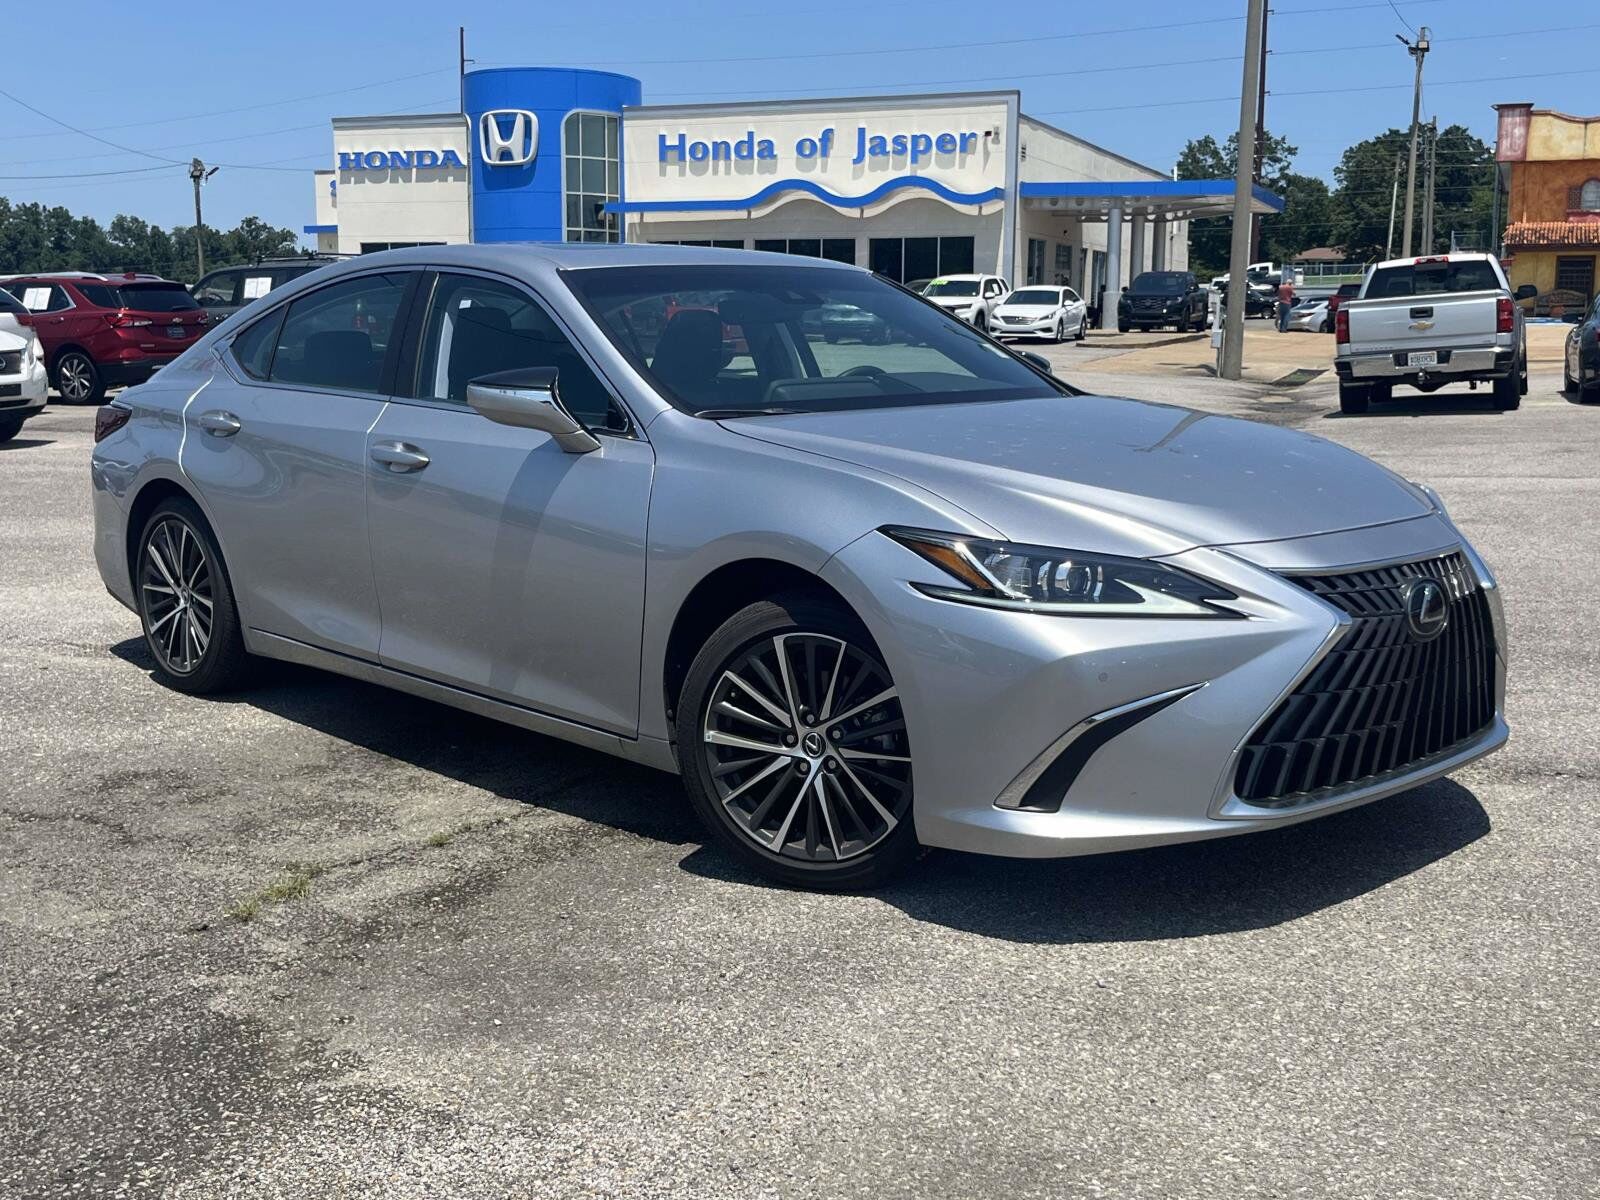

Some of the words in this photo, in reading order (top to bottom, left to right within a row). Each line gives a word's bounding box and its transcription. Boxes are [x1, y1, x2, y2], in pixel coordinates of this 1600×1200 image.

[338, 150, 466, 170] HONDA
[658, 131, 777, 162] Honda
[795, 129, 834, 159] of
[852, 128, 977, 165] Jasper
